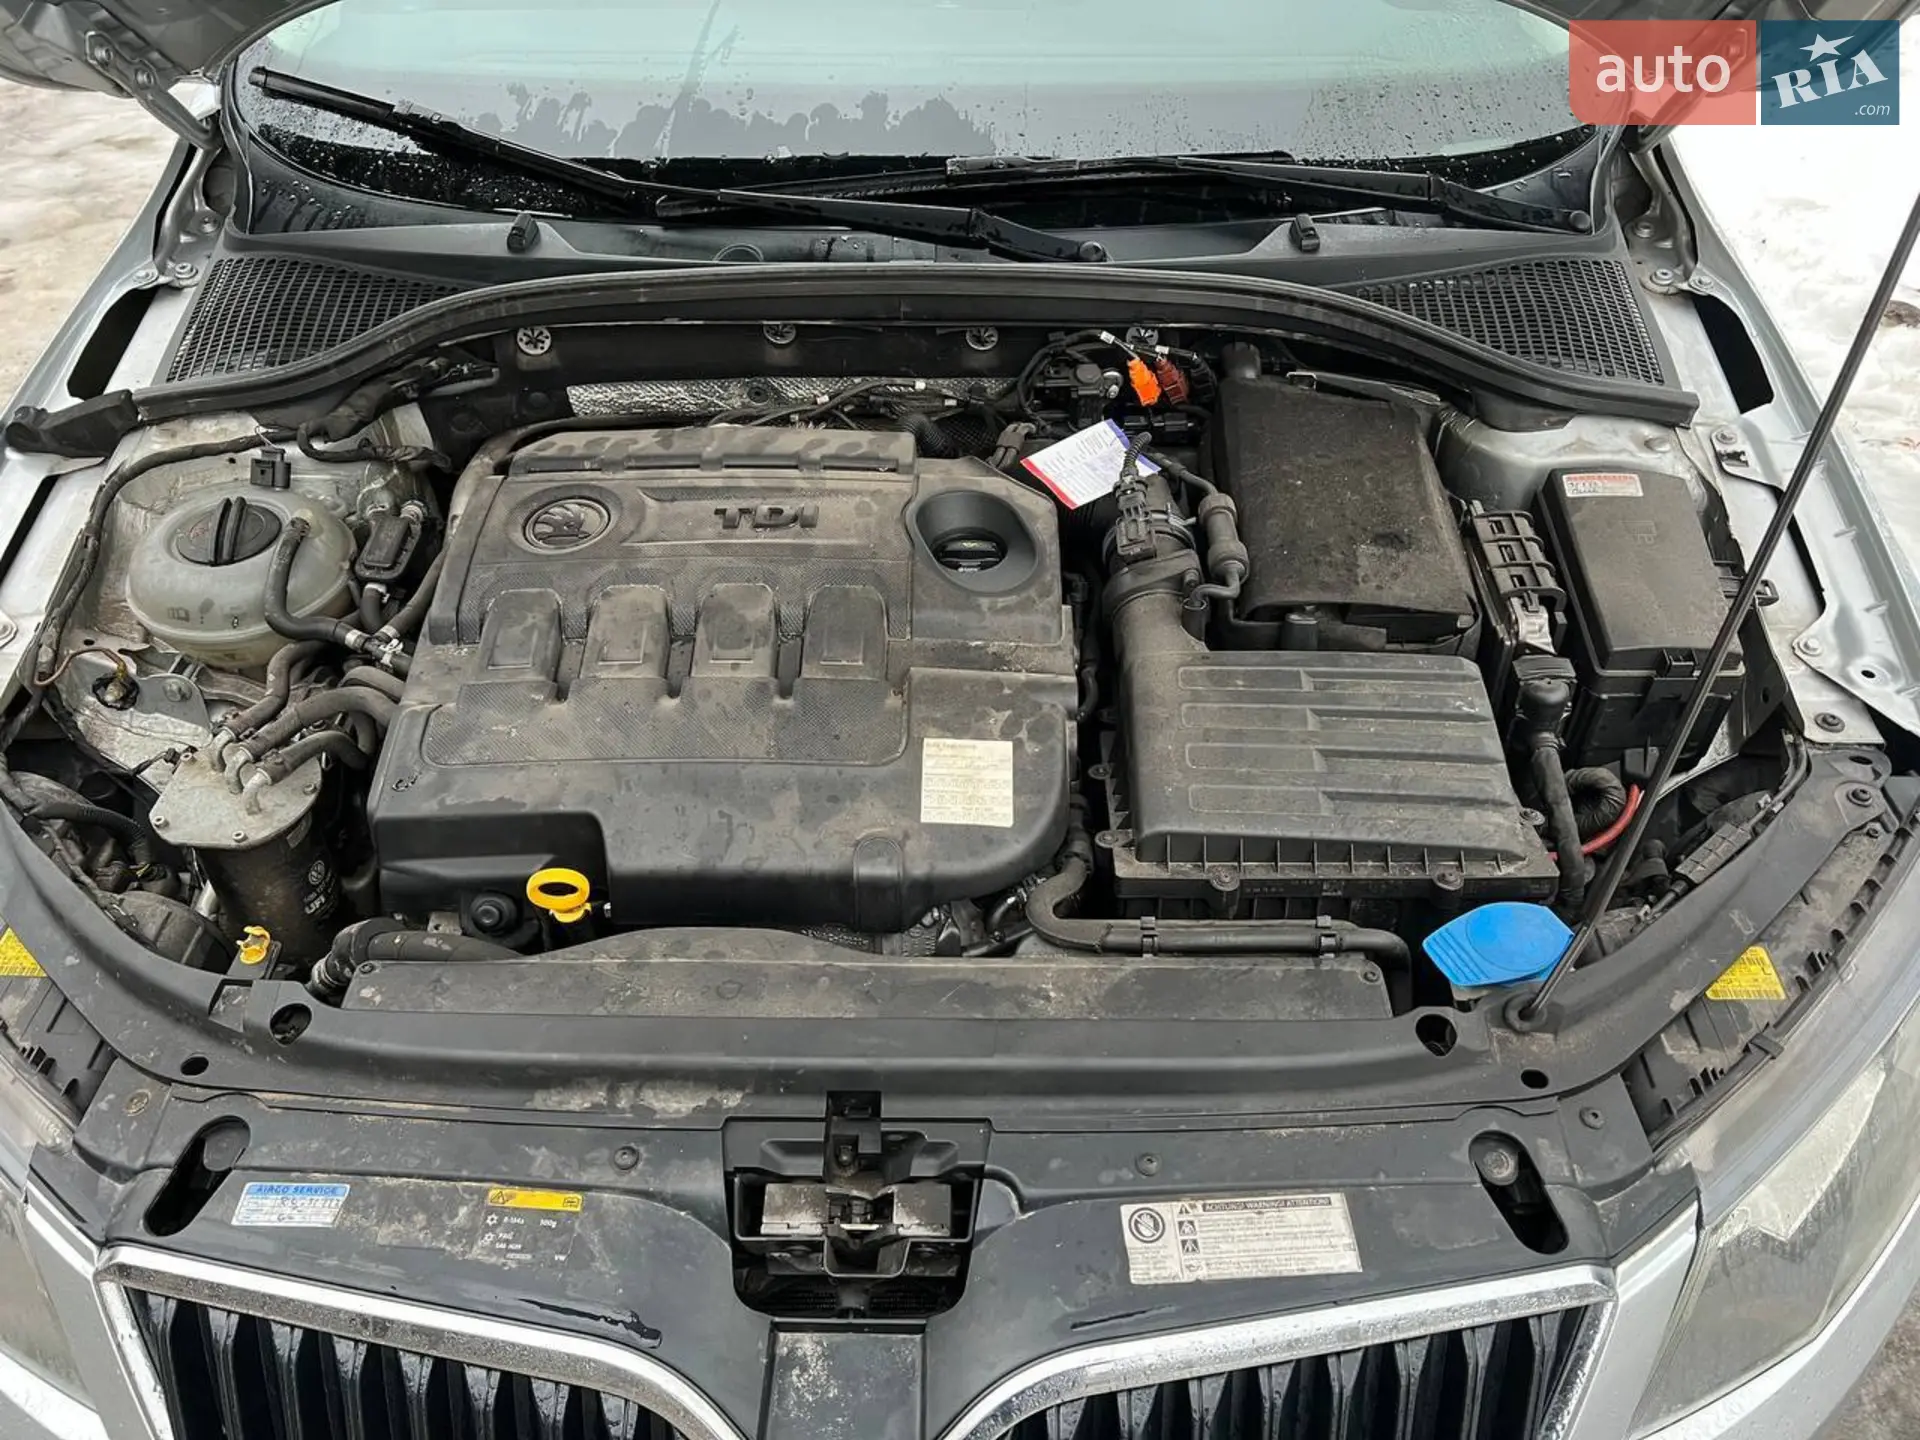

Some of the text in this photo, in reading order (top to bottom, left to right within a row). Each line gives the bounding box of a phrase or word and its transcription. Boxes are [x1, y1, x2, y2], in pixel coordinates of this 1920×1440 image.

[714, 506, 819, 530] TDI
[257, 1185, 337, 1194] AIRCO SERVICE
